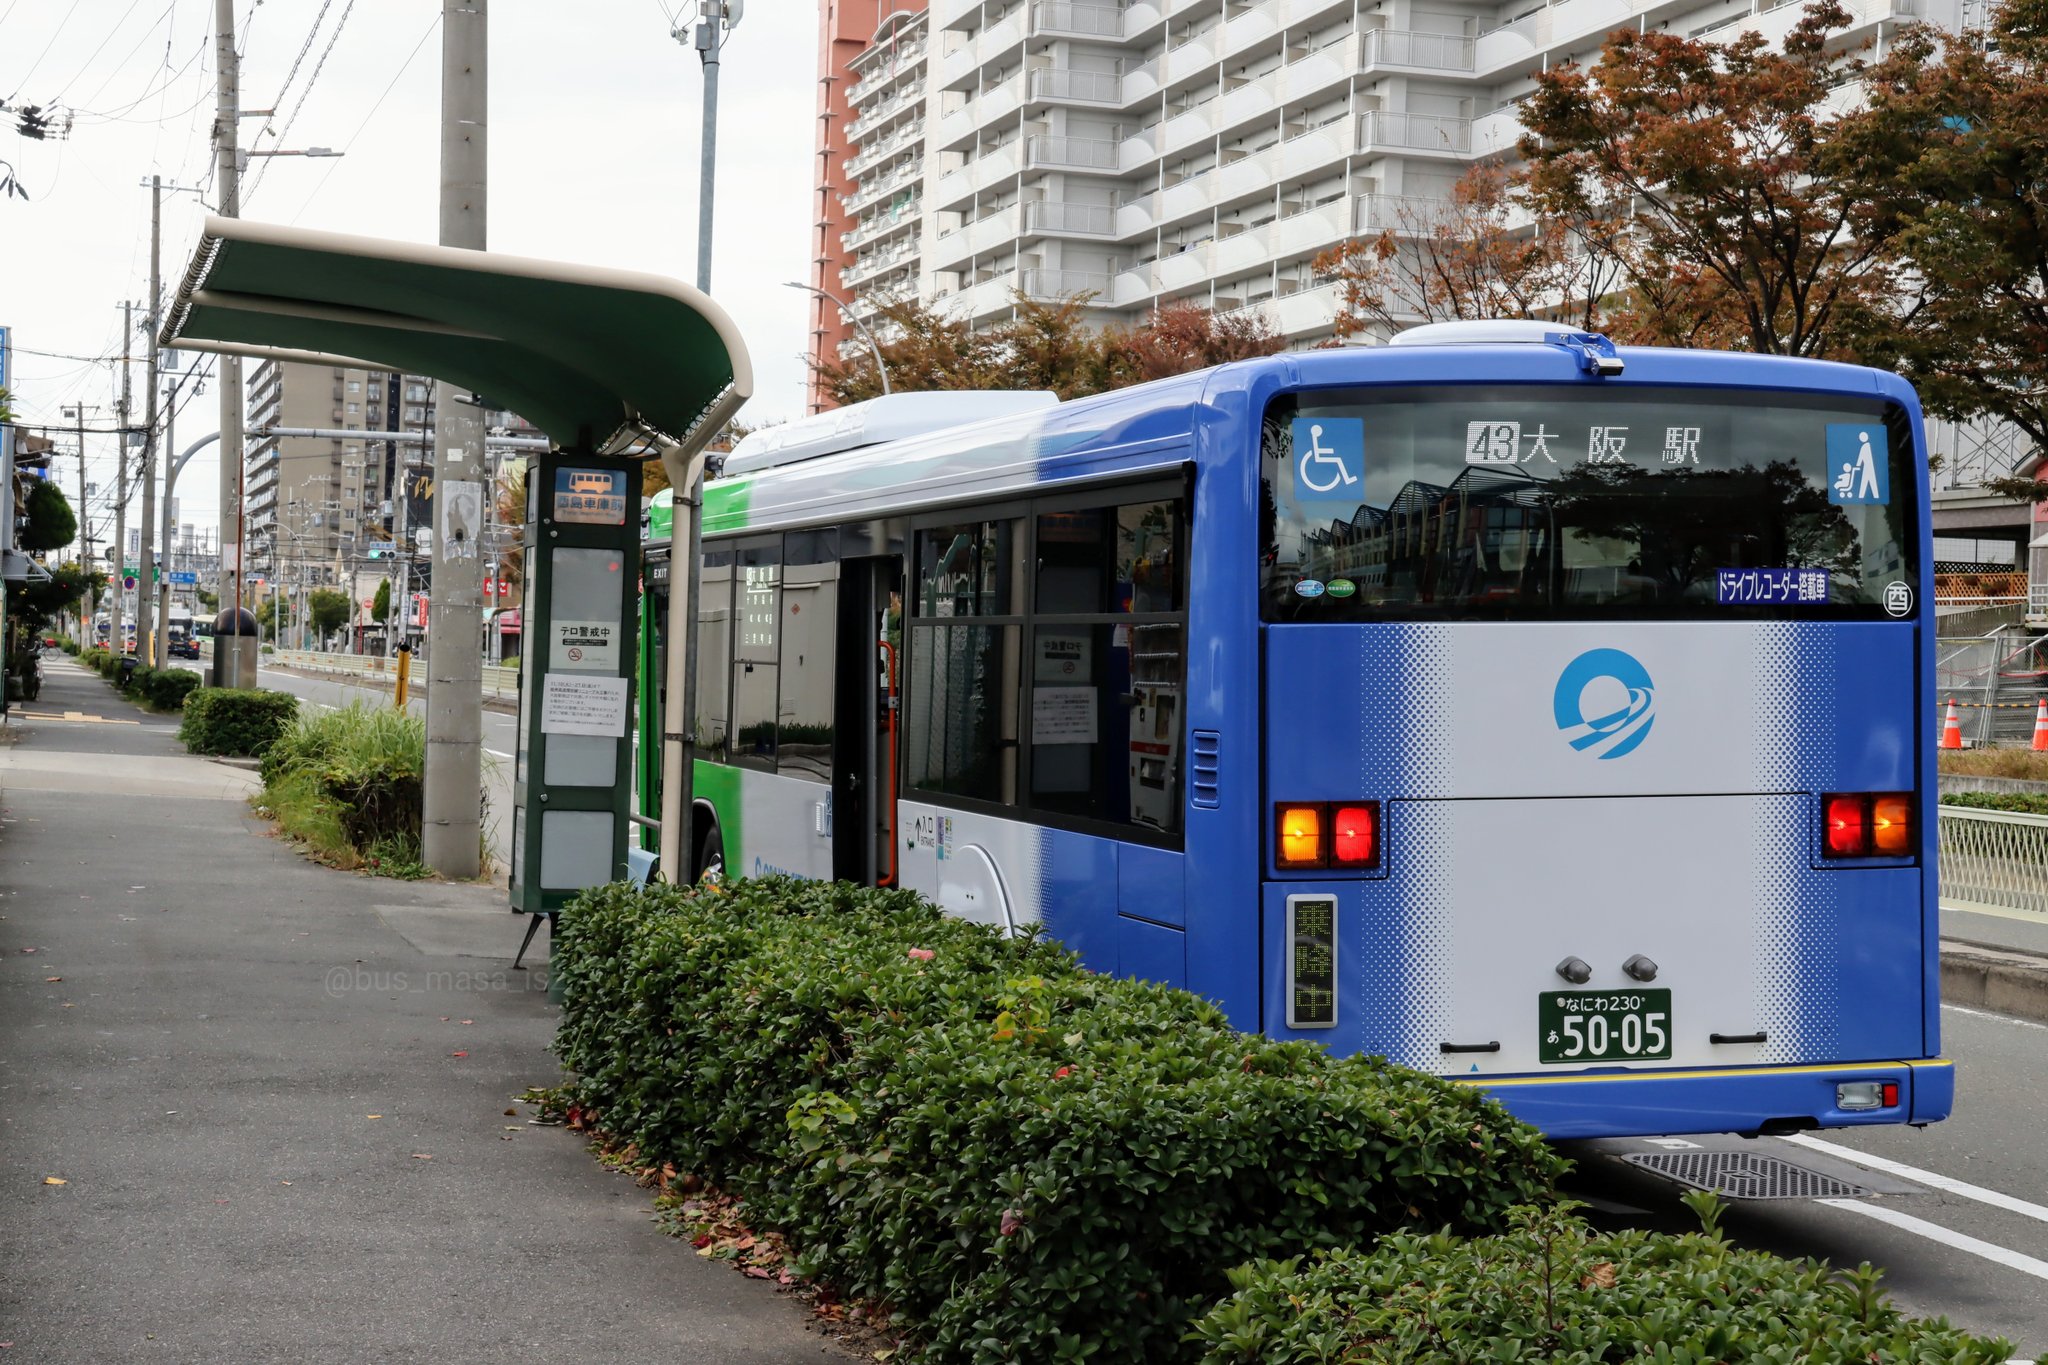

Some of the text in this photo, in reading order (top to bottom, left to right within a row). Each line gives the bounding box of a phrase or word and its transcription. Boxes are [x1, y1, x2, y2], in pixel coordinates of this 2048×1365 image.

[1472, 423, 1701, 464] 43 大阪駅
[653, 567, 668, 579] EXIT
[1719, 571, 1826, 602] ドライブレコーダー搭載車
[560, 626, 610, 638] テロ警戒中
[1296, 903, 1331, 1018] 乗降中
[1565, 996, 1641, 1012] なにわ230
[1547, 1013, 1666, 1057] あ 50-05
